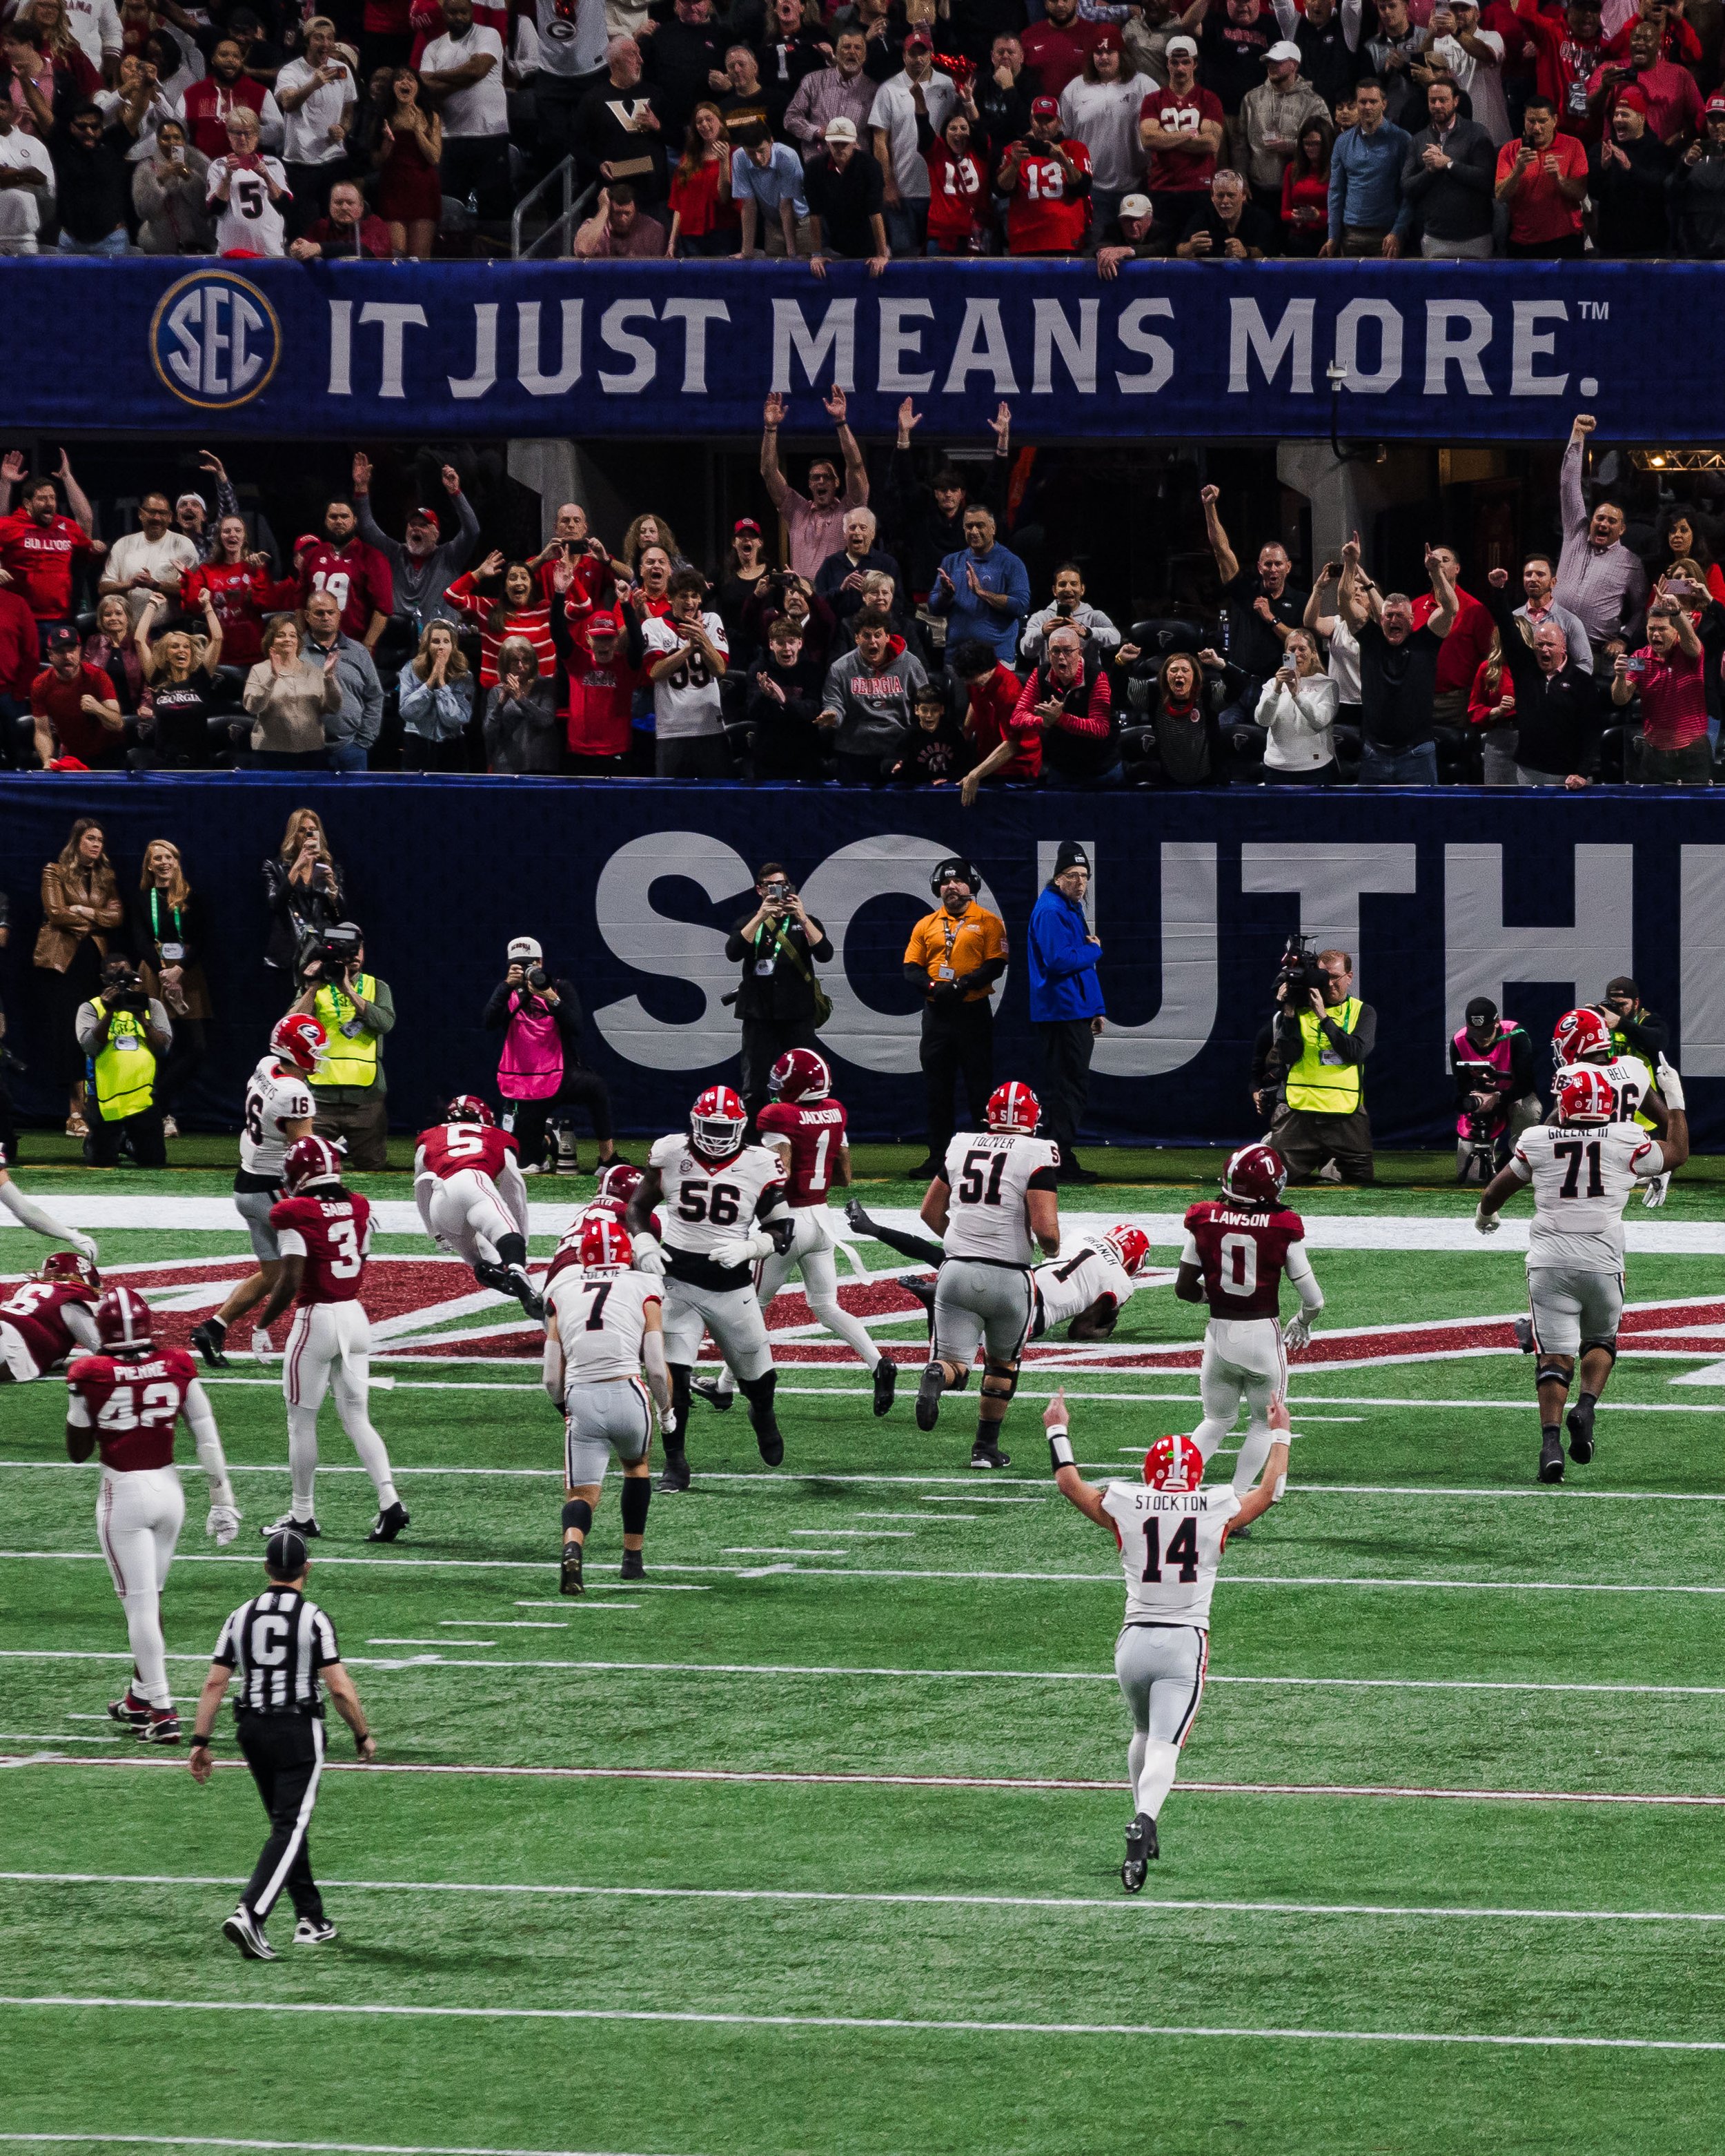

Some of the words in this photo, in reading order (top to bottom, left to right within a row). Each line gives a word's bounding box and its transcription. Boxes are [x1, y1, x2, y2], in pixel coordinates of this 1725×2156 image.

[604, 98, 651, 132] V
[1027, 161, 1063, 199] 13
[238, 181, 263, 219] 5
[168, 286, 264, 394] SEC
[328, 299, 428, 399] IT
[447, 298, 731, 399] JUST
[771, 297, 1174, 394] MEANS
[1226, 297, 1599, 397] MORE.
[850, 675, 904, 695] GEORGIA
[1607, 1067, 1631, 1081] BELL
[291, 1096, 309, 1114] 16
[798, 1107, 842, 1126] JACKSON
[999, 1109, 1018, 1123] 51
[1585, 1098, 1603, 1111] 71
[446, 1123, 483, 1158] 5
[972, 1135, 1015, 1150] TOLIVER
[1548, 1127, 1593, 1140] GREENE
[807, 1129, 829, 1190] 1
[958, 1149, 1008, 1206] 51
[1554, 1140, 1605, 1199] 71
[676, 1180, 741, 1227] 56
[1209, 1209, 1270, 1228] LAWSON
[327, 1219, 363, 1280] 3
[1052, 1247, 1097, 1284] 1
[1083, 1236, 1118, 1266] BRANCH
[1219, 1232, 1257, 1297] 0
[582, 1281, 613, 1332] 7
[97, 1381, 180, 1431] 42
[1135, 1494, 1208, 1512] STOCKTON
[1142, 1516, 1199, 1584] 14
[251, 1615, 290, 1666] C
